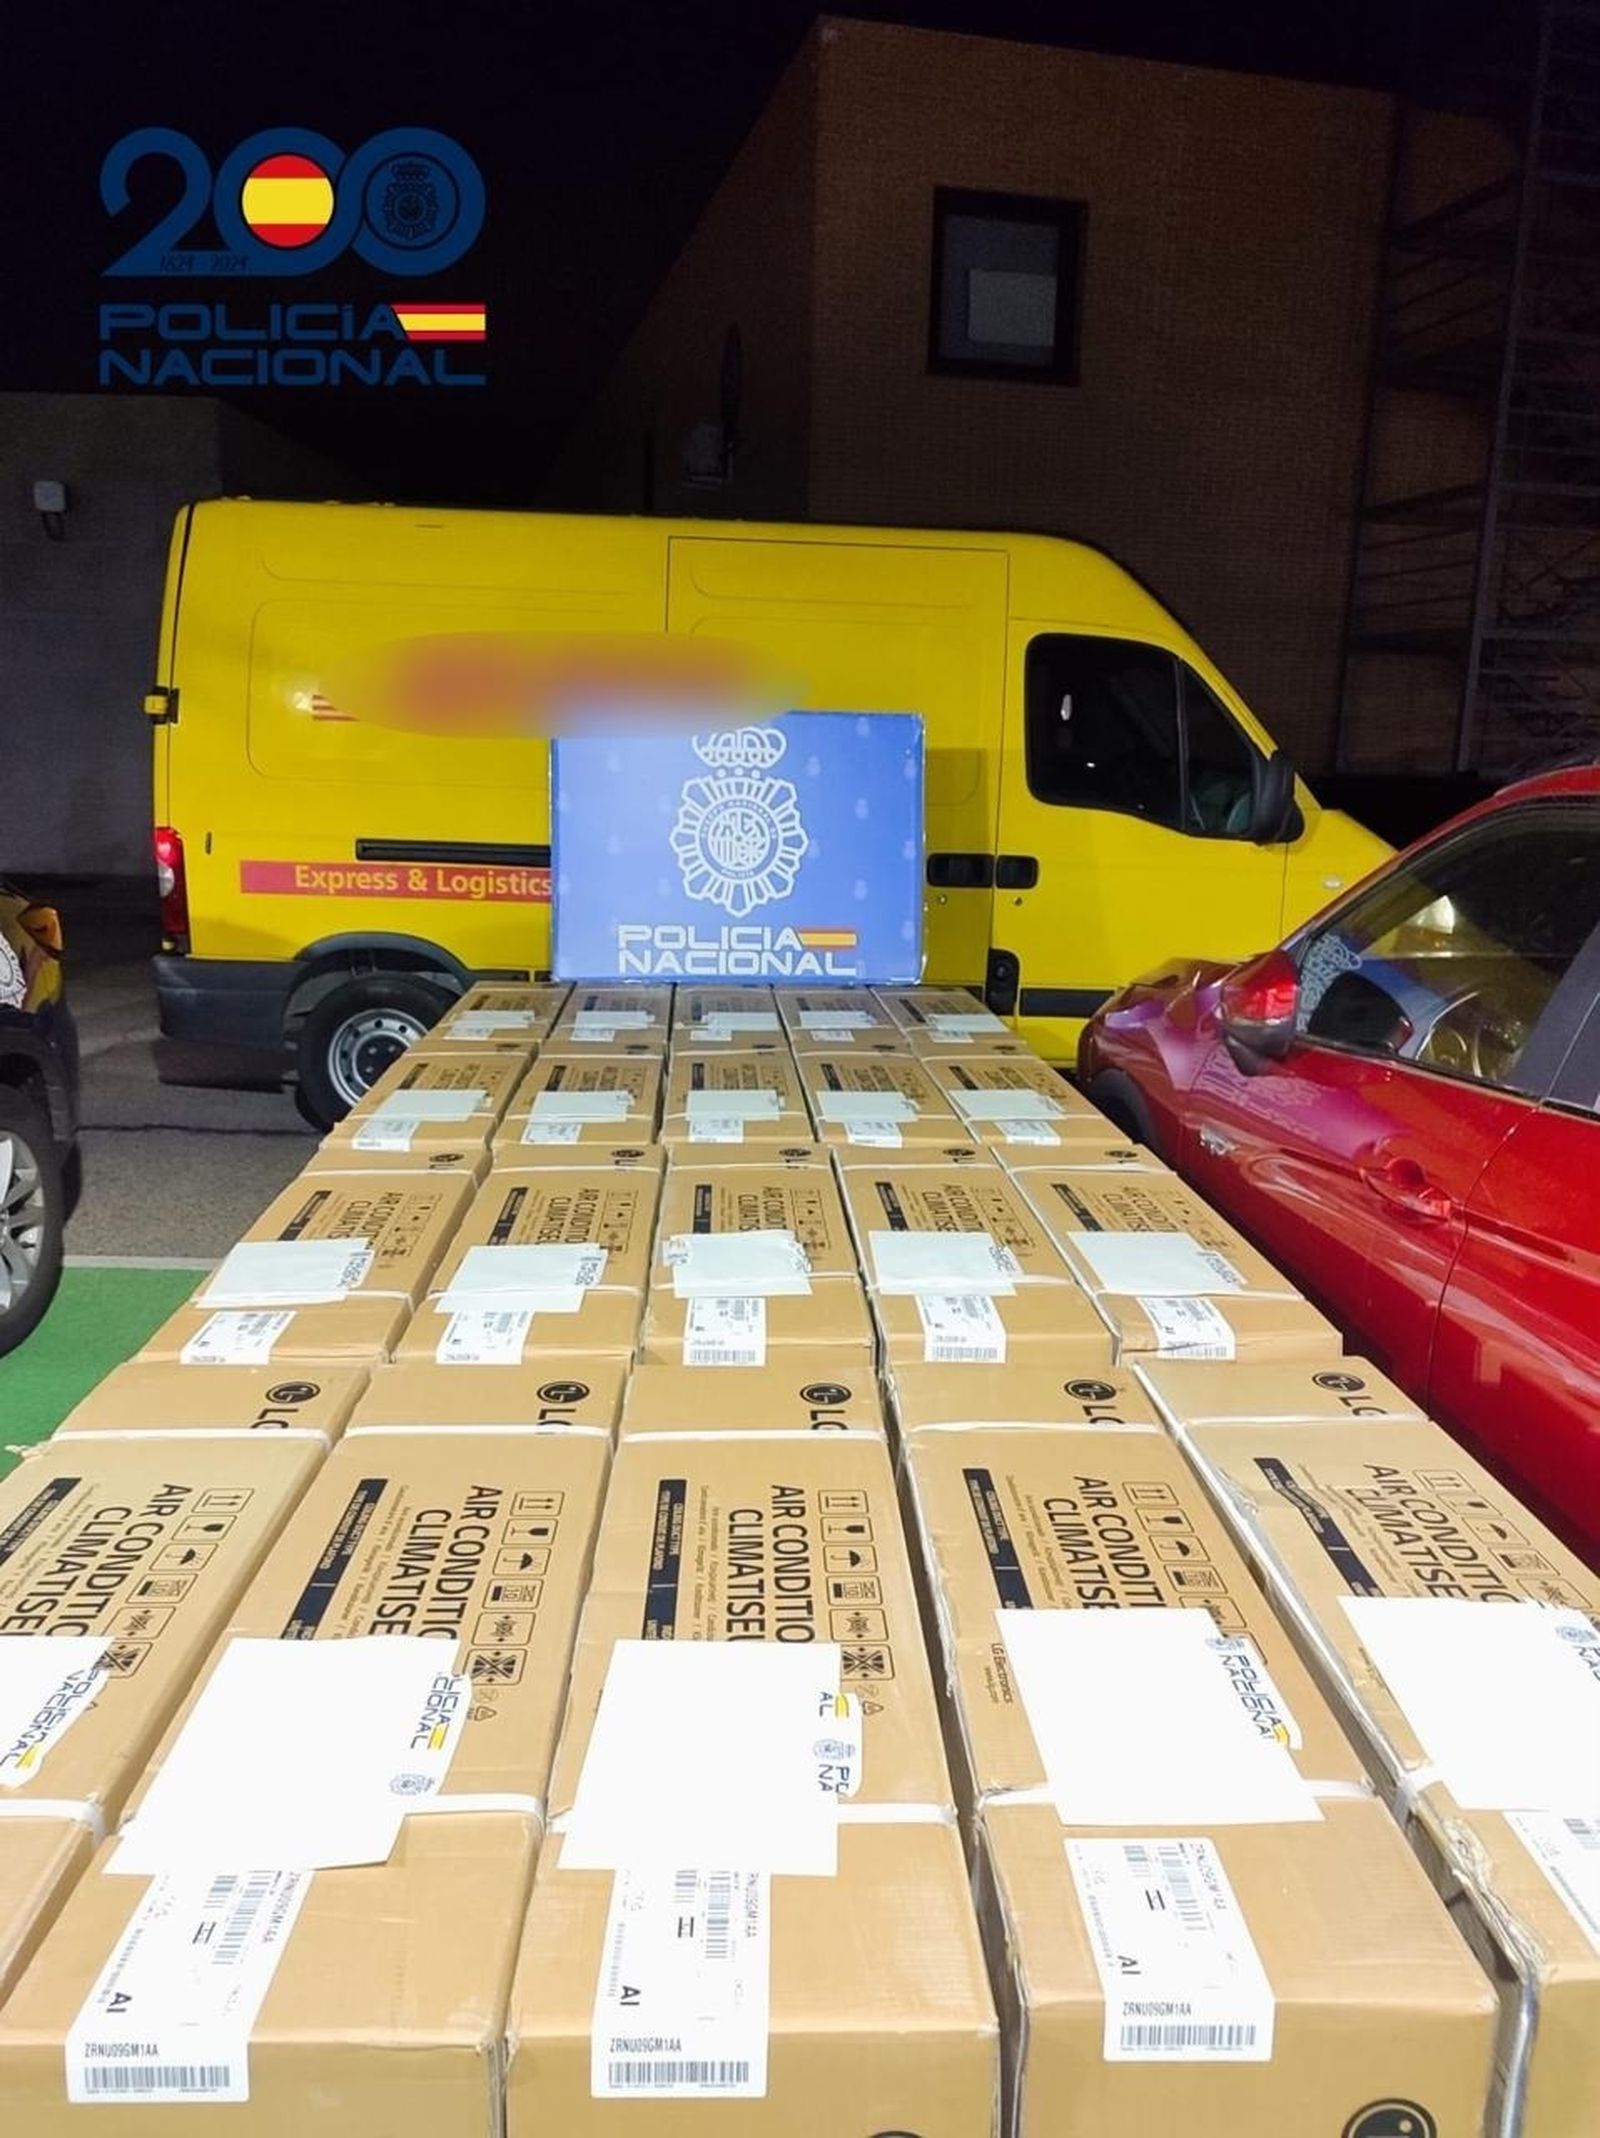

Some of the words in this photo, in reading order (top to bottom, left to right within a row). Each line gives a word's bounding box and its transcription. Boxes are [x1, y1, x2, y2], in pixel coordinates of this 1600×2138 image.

[294, 865, 398, 894] Express
[407, 868, 428, 892] &
[436, 869, 552, 900] Logistics
[618, 950, 858, 977] NACIONAL
[1073, 1475, 1118, 1508] AIR
[1363, 1463, 1418, 1496] AIR
[139, 1483, 193, 1517] AIR
[460, 1484, 504, 1520] AIR
[770, 1484, 806, 1519] AIR
[367, 1508, 452, 1635] CLIMATISE
[1091, 1513, 1168, 1607] CONDITI
[771, 1524, 816, 1643] CONDITIO
[819, 1691, 834, 1718] AL
[817, 1763, 835, 1792] NA
[1117, 1954, 1142, 1976] AI
[105, 1991, 132, 2014] AI
[619, 1984, 642, 2007] AI
